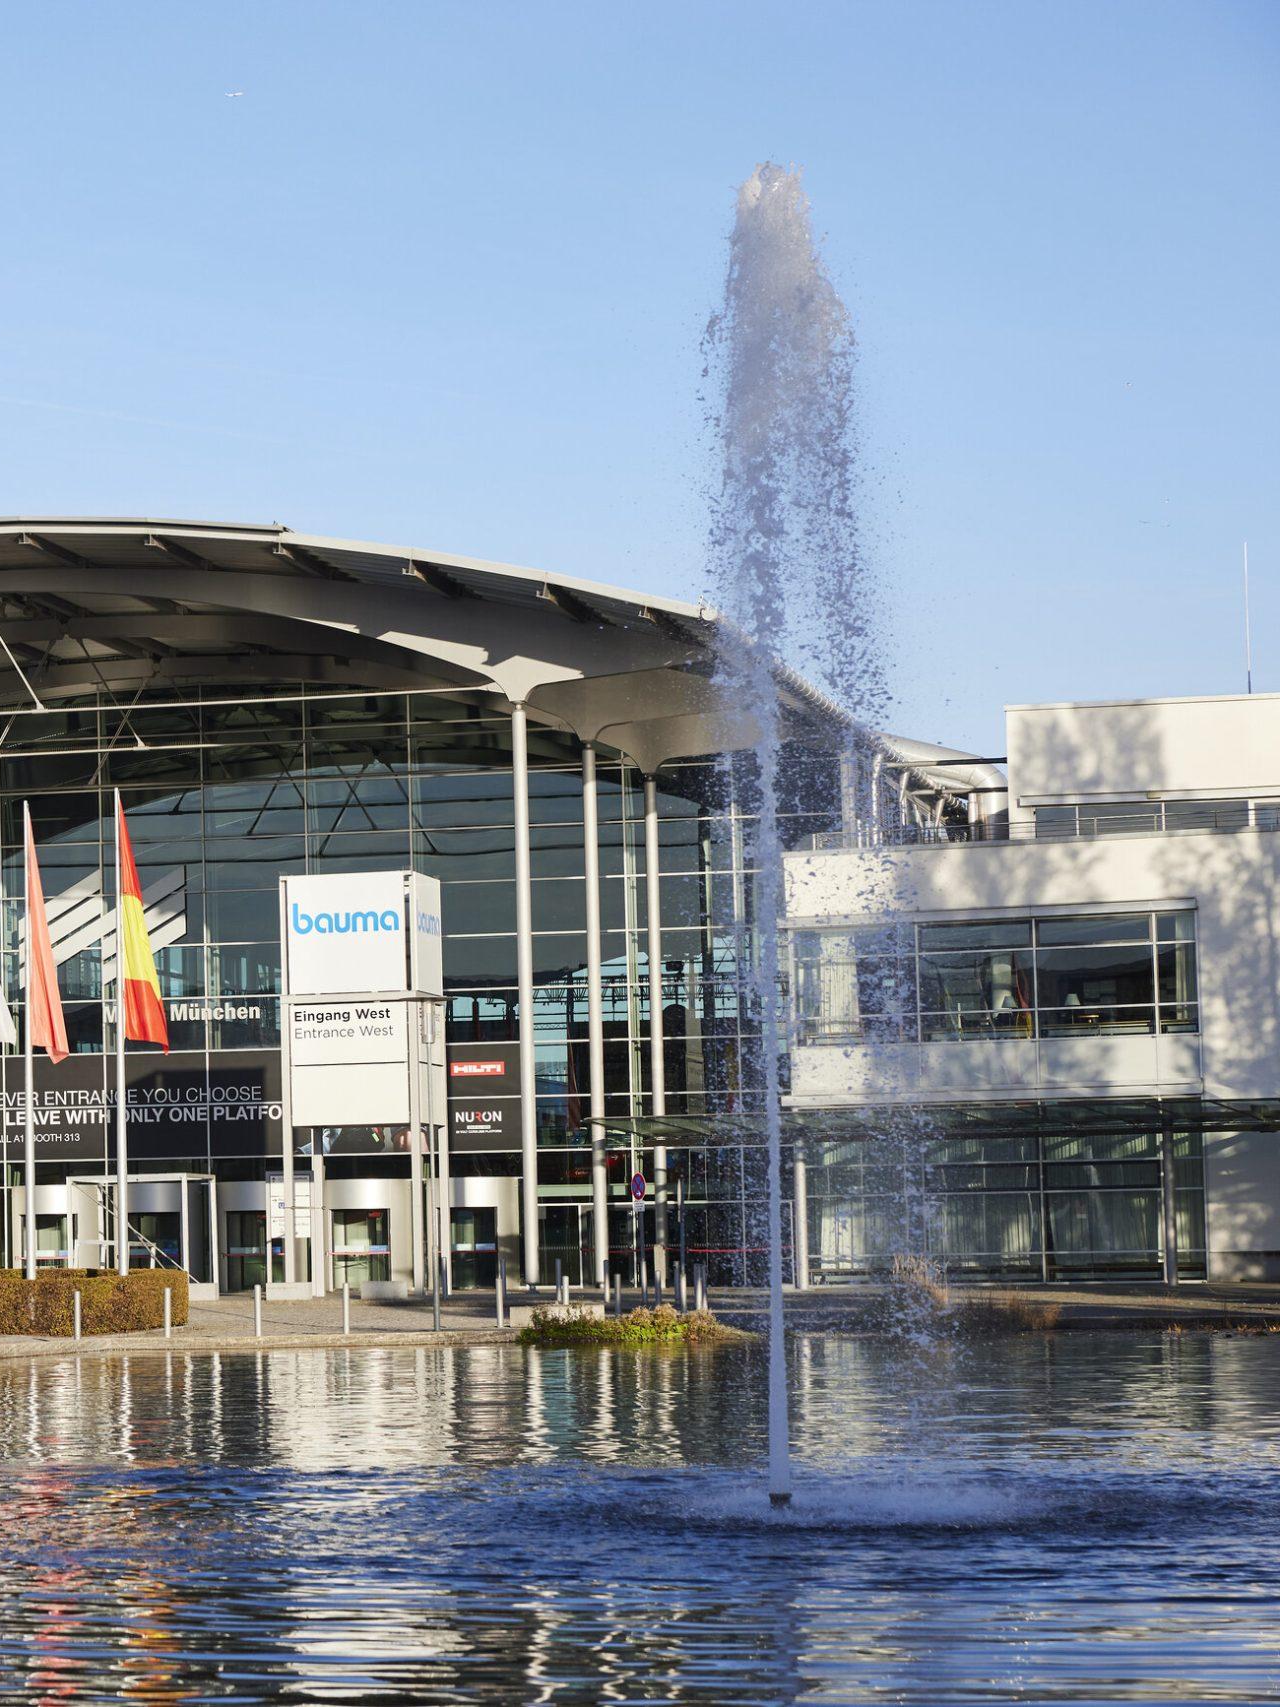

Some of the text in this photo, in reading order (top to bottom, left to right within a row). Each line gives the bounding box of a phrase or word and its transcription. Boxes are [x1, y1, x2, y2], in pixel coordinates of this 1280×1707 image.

[293, 902, 400, 935] bauma
[170, 1002, 261, 1022] München
[294, 1008, 391, 1024] Eingang West
[294, 1025, 394, 1040] Entrance West
[142, 1087, 180, 1104] YOU
[185, 1085, 262, 1103] CHOOSE
[64, 1108, 111, 1125] WITH
[169, 1106, 209, 1122] ONE
[213, 1104, 283, 1121] PLATFO
[455, 1110, 503, 1123] NURON
[13, 1134, 24, 1143] A1
[64, 1132, 81, 1142] 313
